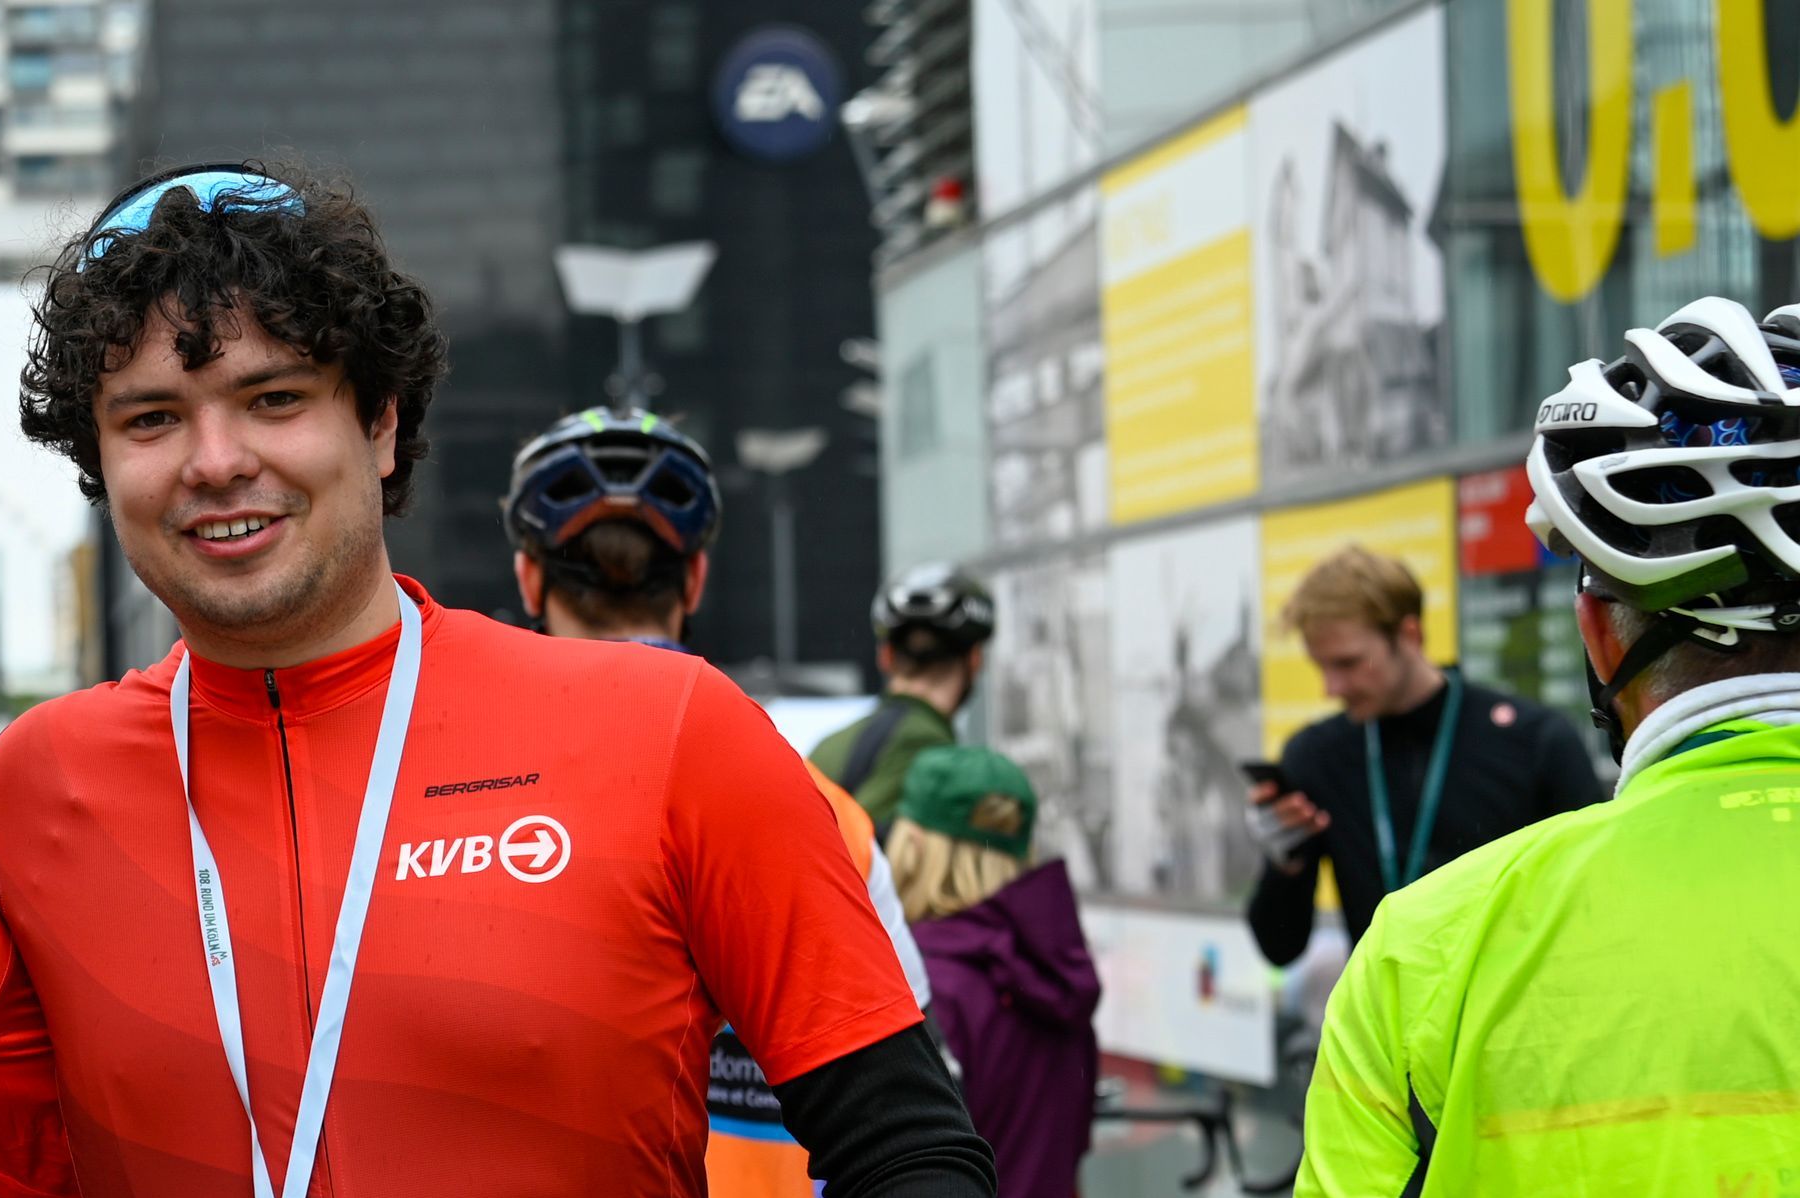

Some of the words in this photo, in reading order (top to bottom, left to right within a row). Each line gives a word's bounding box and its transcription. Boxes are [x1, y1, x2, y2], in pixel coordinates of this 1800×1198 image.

[1551, 402, 1598, 423] GIRO
[423, 772, 541, 799] BERGRISAR
[395, 834, 494, 881] KVB
[200, 887, 214, 912] RUND
[204, 912, 217, 927] UM
